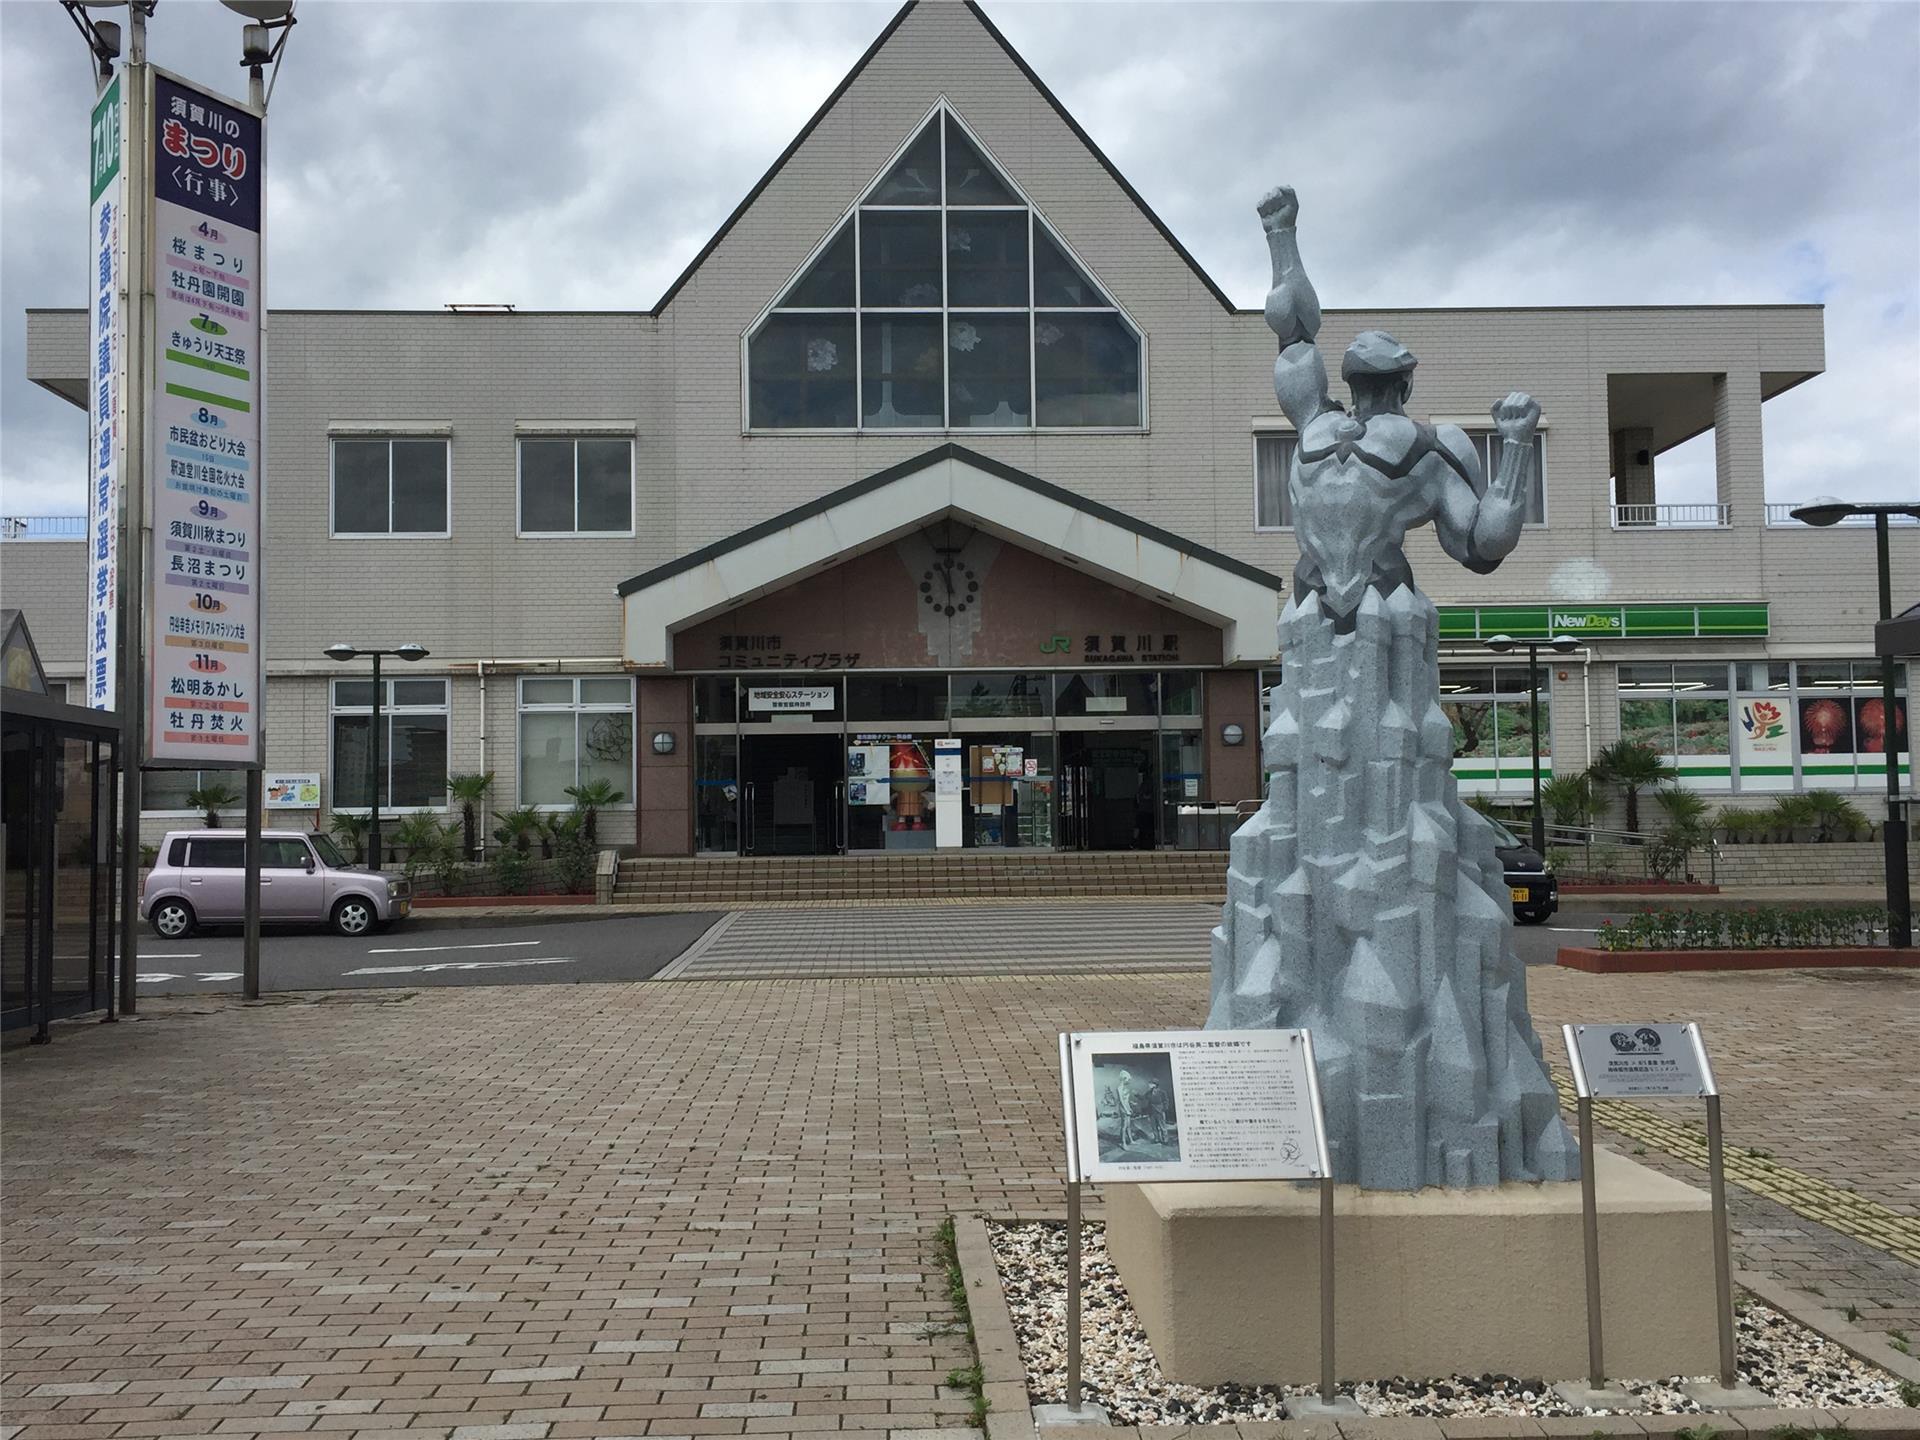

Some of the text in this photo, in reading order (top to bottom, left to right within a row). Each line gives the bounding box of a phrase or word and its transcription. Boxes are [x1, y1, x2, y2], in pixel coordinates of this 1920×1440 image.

[171, 95, 240, 138] 須賀川の
[162, 118, 246, 180] まつり
[198, 221, 219, 241] 4月
[173, 236, 243, 273] 桜まつり
[172, 270, 244, 307] 牡丹園開園
[200, 313, 219, 332] 7月
[172, 331, 246, 365] きゅうり天王祭
[198, 407, 219, 426] 8月
[169, 426, 246, 457] 市民盆おどり大会
[95, 201, 112, 709] 参議院議員通常選挙投票
[198, 500, 219, 518] 9月
[170, 520, 246, 548] 須賀川秋まつり
[171, 555, 245, 580] 長沼まつり
[195, 593, 221, 611] 10月
[169, 616, 245, 640] 円谷幸吉メモリアルマラソン大会
[1554, 614, 1620, 630] NewDays
[720, 635, 781, 650] 須賀川市
[1040, 636, 1072, 654] JR
[1085, 635, 1179, 652] 須賀川駅
[195, 653, 219, 670] 11月
[718, 652, 861, 668] コミュニティプラザ
[1085, 654, 1179, 663] SUKAGAWA STATION
[170, 677, 243, 698] 松明あかし
[170, 712, 243, 732] 牡丹焚火
